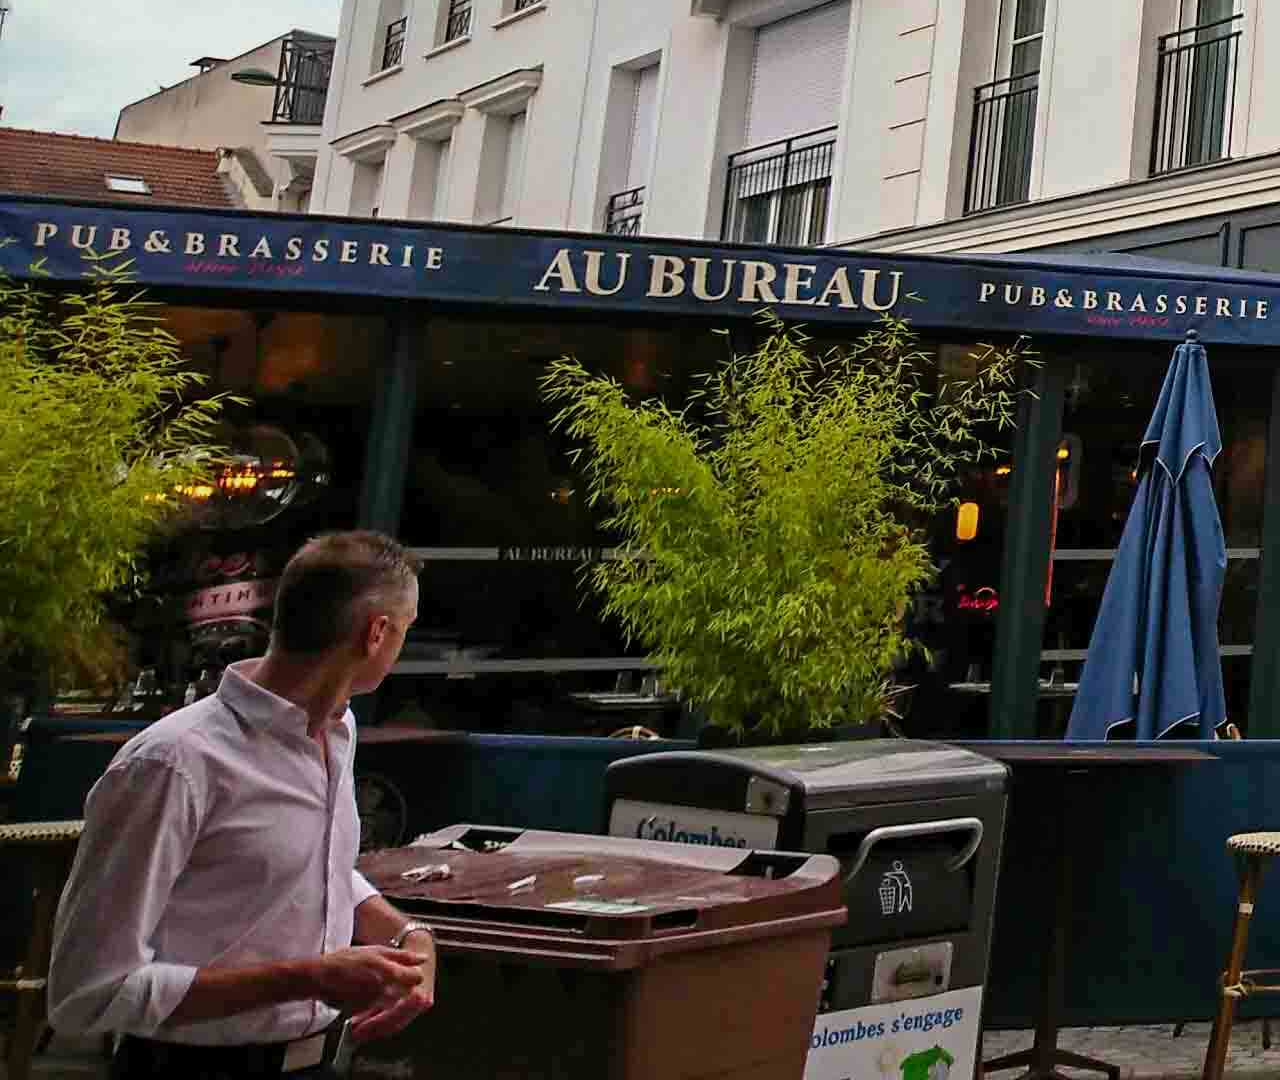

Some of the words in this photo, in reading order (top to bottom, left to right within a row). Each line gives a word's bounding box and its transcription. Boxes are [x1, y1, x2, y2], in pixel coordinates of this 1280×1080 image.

[33, 222, 447, 271] PUB&BRASSERIE
[533, 247, 632, 296] AU
[645, 253, 904, 311] BUREAU
[977, 281, 1270, 320] PUB&BRASSERIE
[808, 1021, 884, 1049] olombes
[890, 1007, 963, 1032] s'engage
